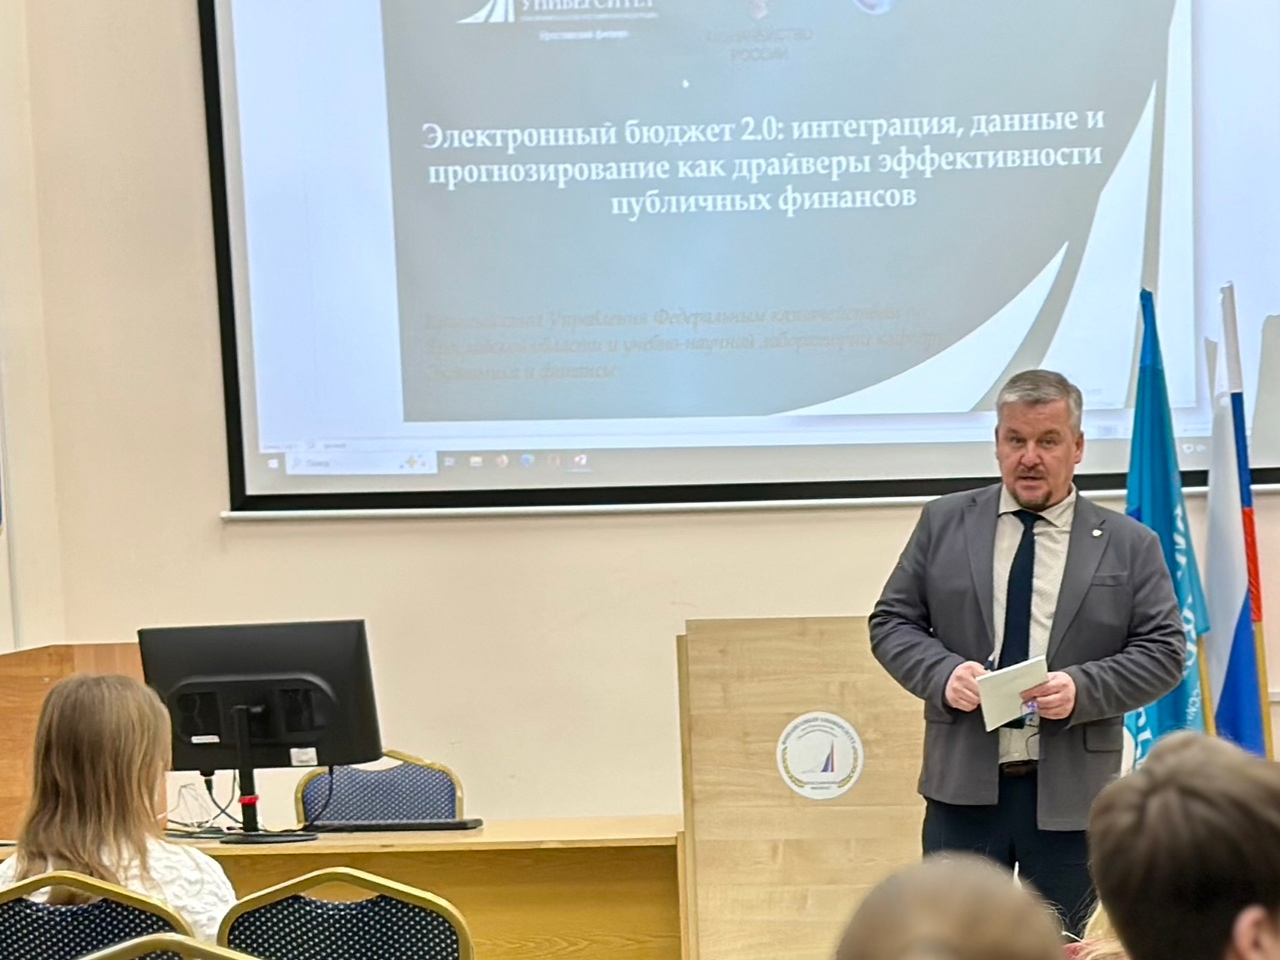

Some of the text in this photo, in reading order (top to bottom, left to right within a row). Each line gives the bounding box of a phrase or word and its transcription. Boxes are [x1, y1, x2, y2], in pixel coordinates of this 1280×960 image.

[421, 110, 1106, 154] Электронный бюджет 2.0: интеграция, данные и
[428, 144, 1103, 191] прогнозирование как драйверы эффективности
[610, 184, 917, 221] публичных финансов
